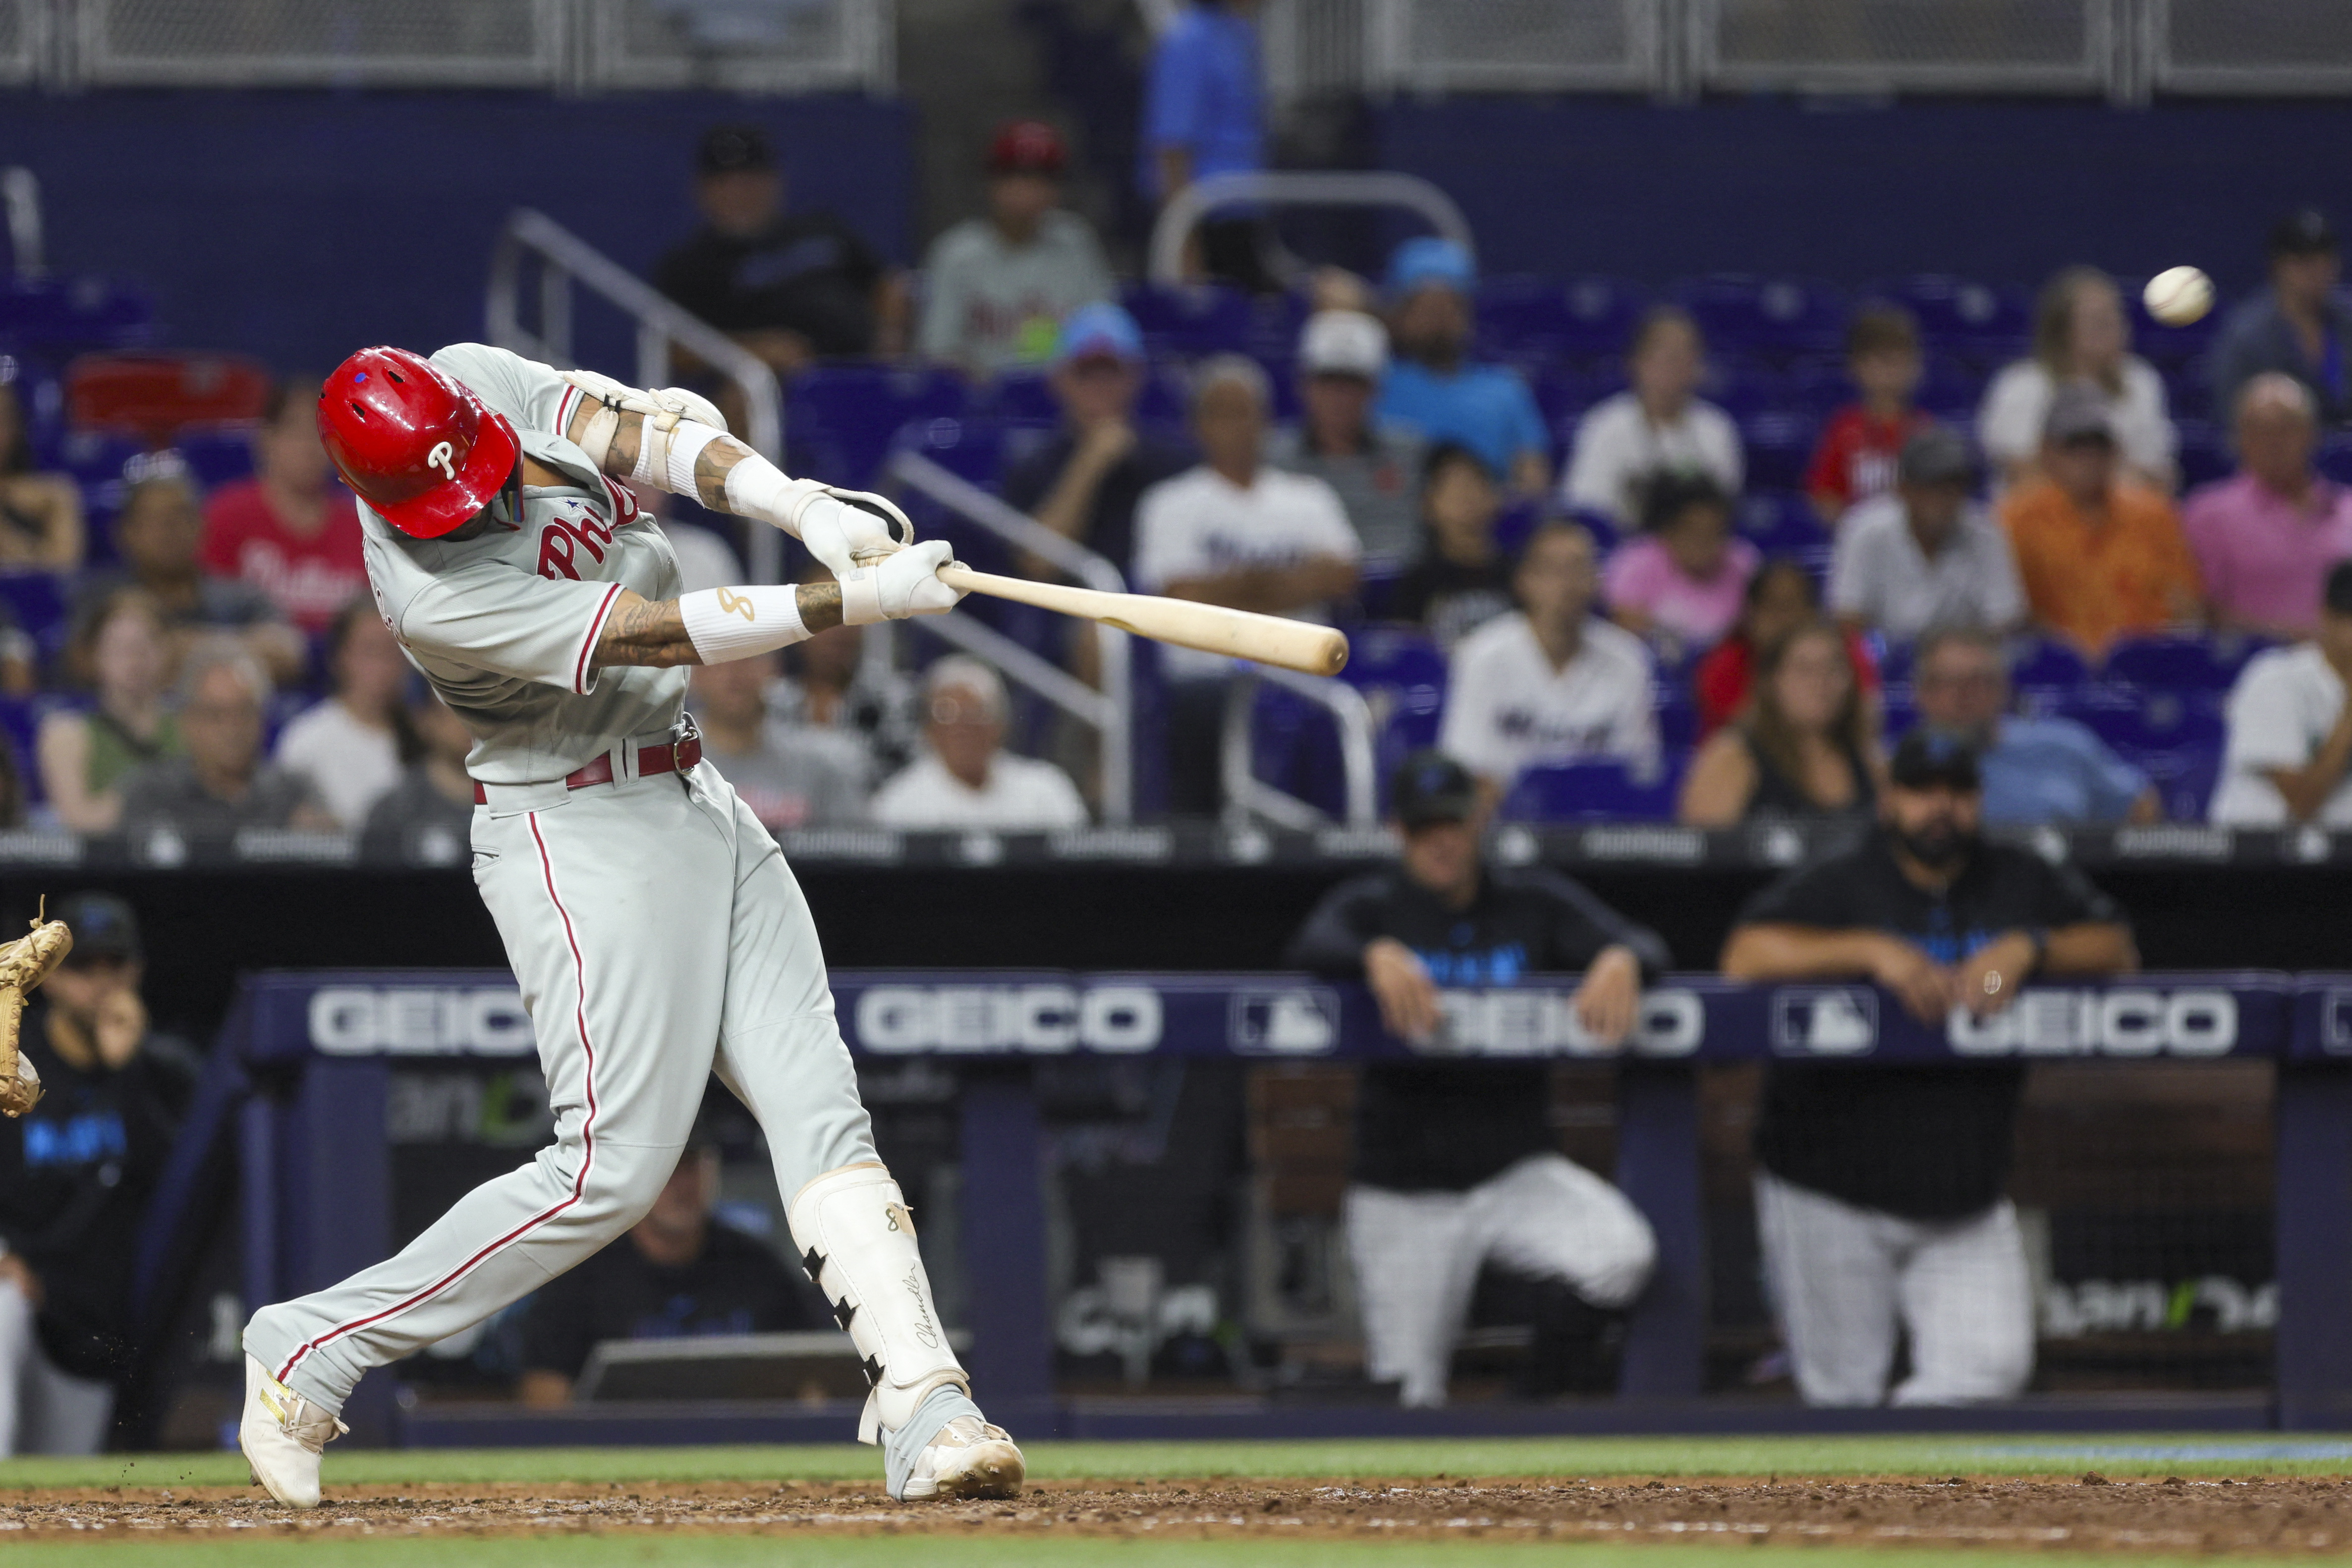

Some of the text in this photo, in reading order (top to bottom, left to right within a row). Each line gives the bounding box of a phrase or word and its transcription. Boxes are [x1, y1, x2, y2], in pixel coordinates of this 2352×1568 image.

[427, 441, 455, 481] P
[717, 586, 755, 622] 8
[308, 984, 537, 1057] GEIC
[854, 983, 1165, 1056] GEICO
[885, 1208, 899, 1232] 8
[901, 1262, 939, 1349] Chandler
